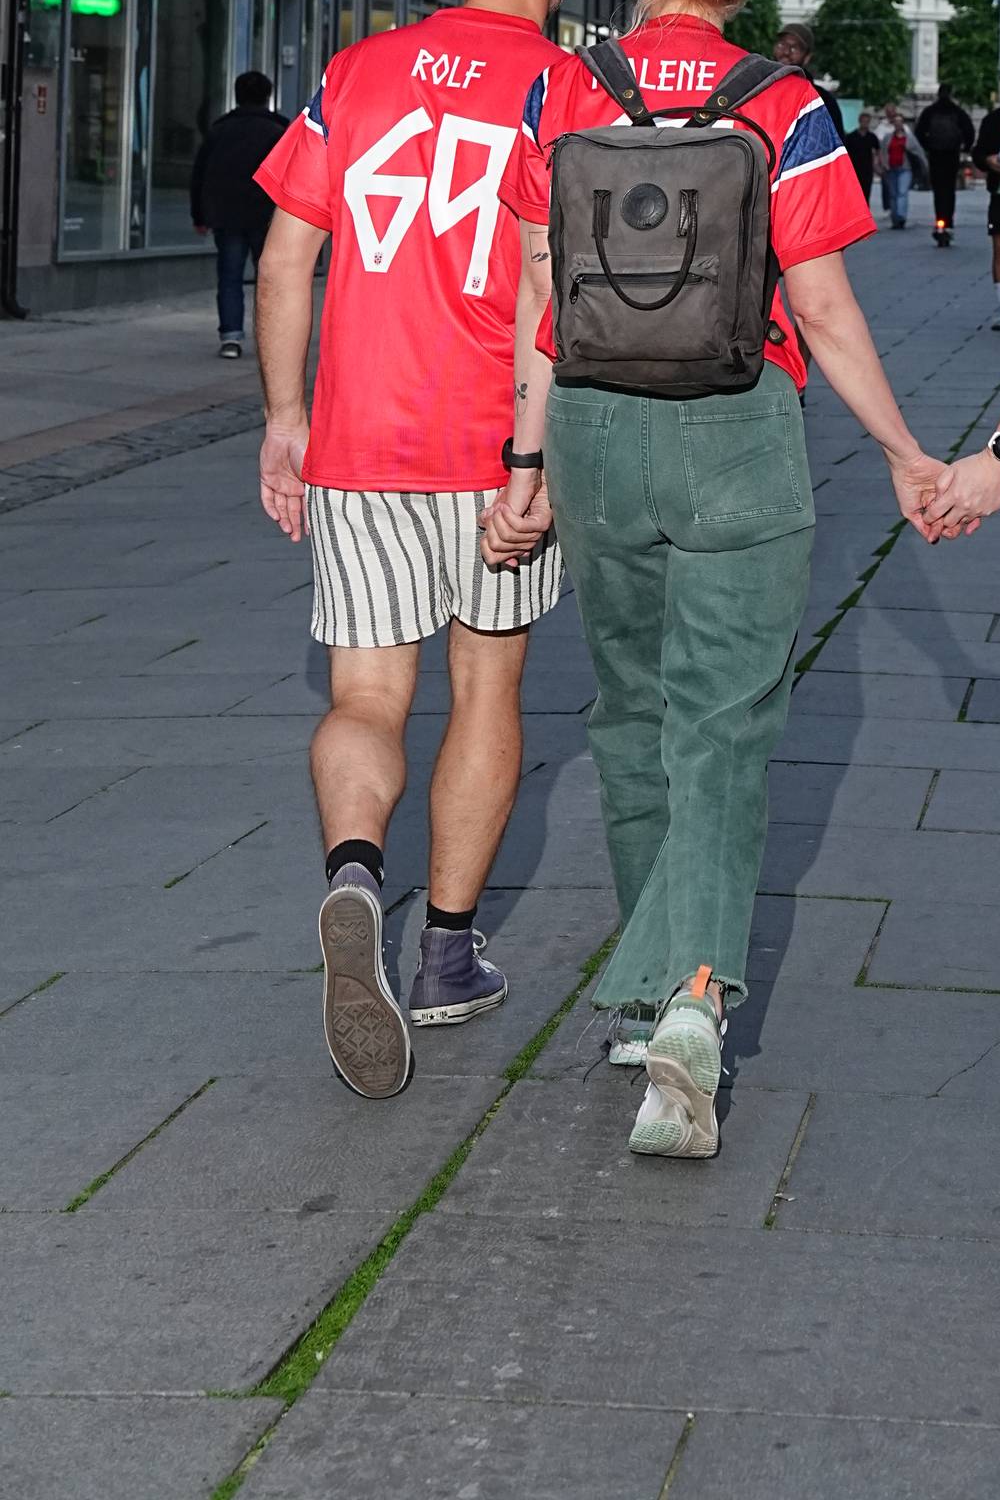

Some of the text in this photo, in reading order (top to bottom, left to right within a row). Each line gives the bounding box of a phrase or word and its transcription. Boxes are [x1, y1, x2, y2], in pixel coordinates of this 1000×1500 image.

[410, 48, 487, 90] ROLF
[592, 57, 717, 92] LENE
[343, 106, 519, 298] 69
